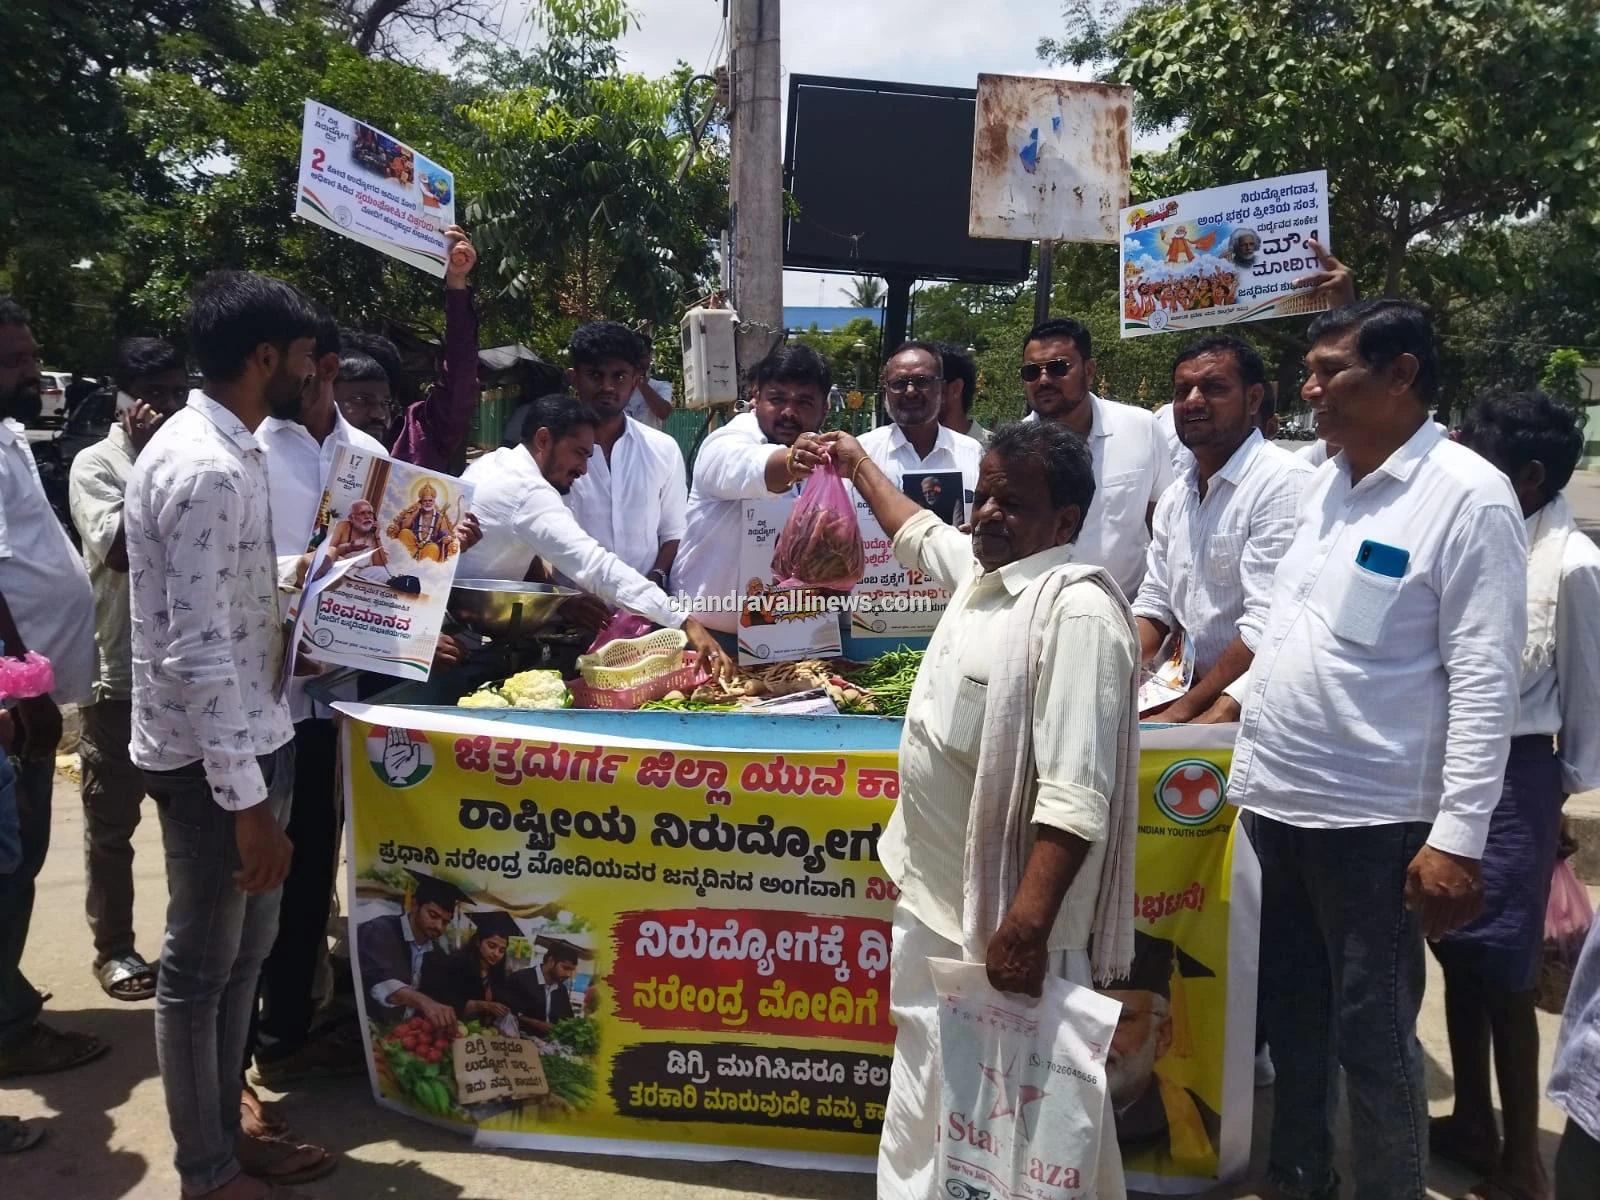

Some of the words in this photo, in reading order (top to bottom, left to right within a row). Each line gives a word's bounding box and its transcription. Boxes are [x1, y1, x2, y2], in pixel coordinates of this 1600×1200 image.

[311, 148, 326, 172] 2
[1197, 213, 1223, 226] ಅಂಧ
[1226, 207, 1250, 224] ಭಕ್ತರ
[1253, 202, 1290, 219] ಪ್ರೀತಿಯ
[1238, 283, 1278, 299] ಜನ್ಮದಿನದ
[349, 454, 363, 466] 17
[907, 569, 923, 585] 12
[319, 598, 412, 631] ದೇವಮಾನವ
[454, 735, 629, 786] ಚಿತ್ರದುರ್ಗ
[636, 751, 733, 806] ಜಿಲ್ಲಾ
[740, 755, 846, 797] ಯುವ
[458, 798, 636, 851] ರಾಷ್ಟ್ರೀಯ
[651, 812, 882, 874] ನಿರುದ್ಯೋಗ
[1137, 825, 1165, 836] INDIAN
[1167, 827, 1195, 838] YOUTH
[378, 840, 439, 865] ಪ್ರಧಾನಿ
[445, 848, 522, 878] ನರೇಂದ್ರ
[527, 851, 656, 883] ಮೋದಿಯವರ
[663, 866, 753, 897] ಜನ್ಮದಿನದ
[760, 875, 855, 898] ಅಂಗವಾಗಿ
[635, 919, 850, 982] ನಿರುದ್ಯೋಗಕ್ಕೆ
[633, 974, 748, 1025] ನರೇಂದ್ರ
[758, 979, 878, 1026] ಮೋದಿಗೆ
[667, 1049, 710, 1084] ಡಿಗ್ರಿ
[717, 1054, 845, 1083] ಮುಗಿಸಿದರೂ
[629, 1082, 698, 1108] ತರಕಾರಿ
[703, 1089, 810, 1117] ಮಾರುವುದೇ
[816, 1098, 863, 1128] ನಮ್ಮ
